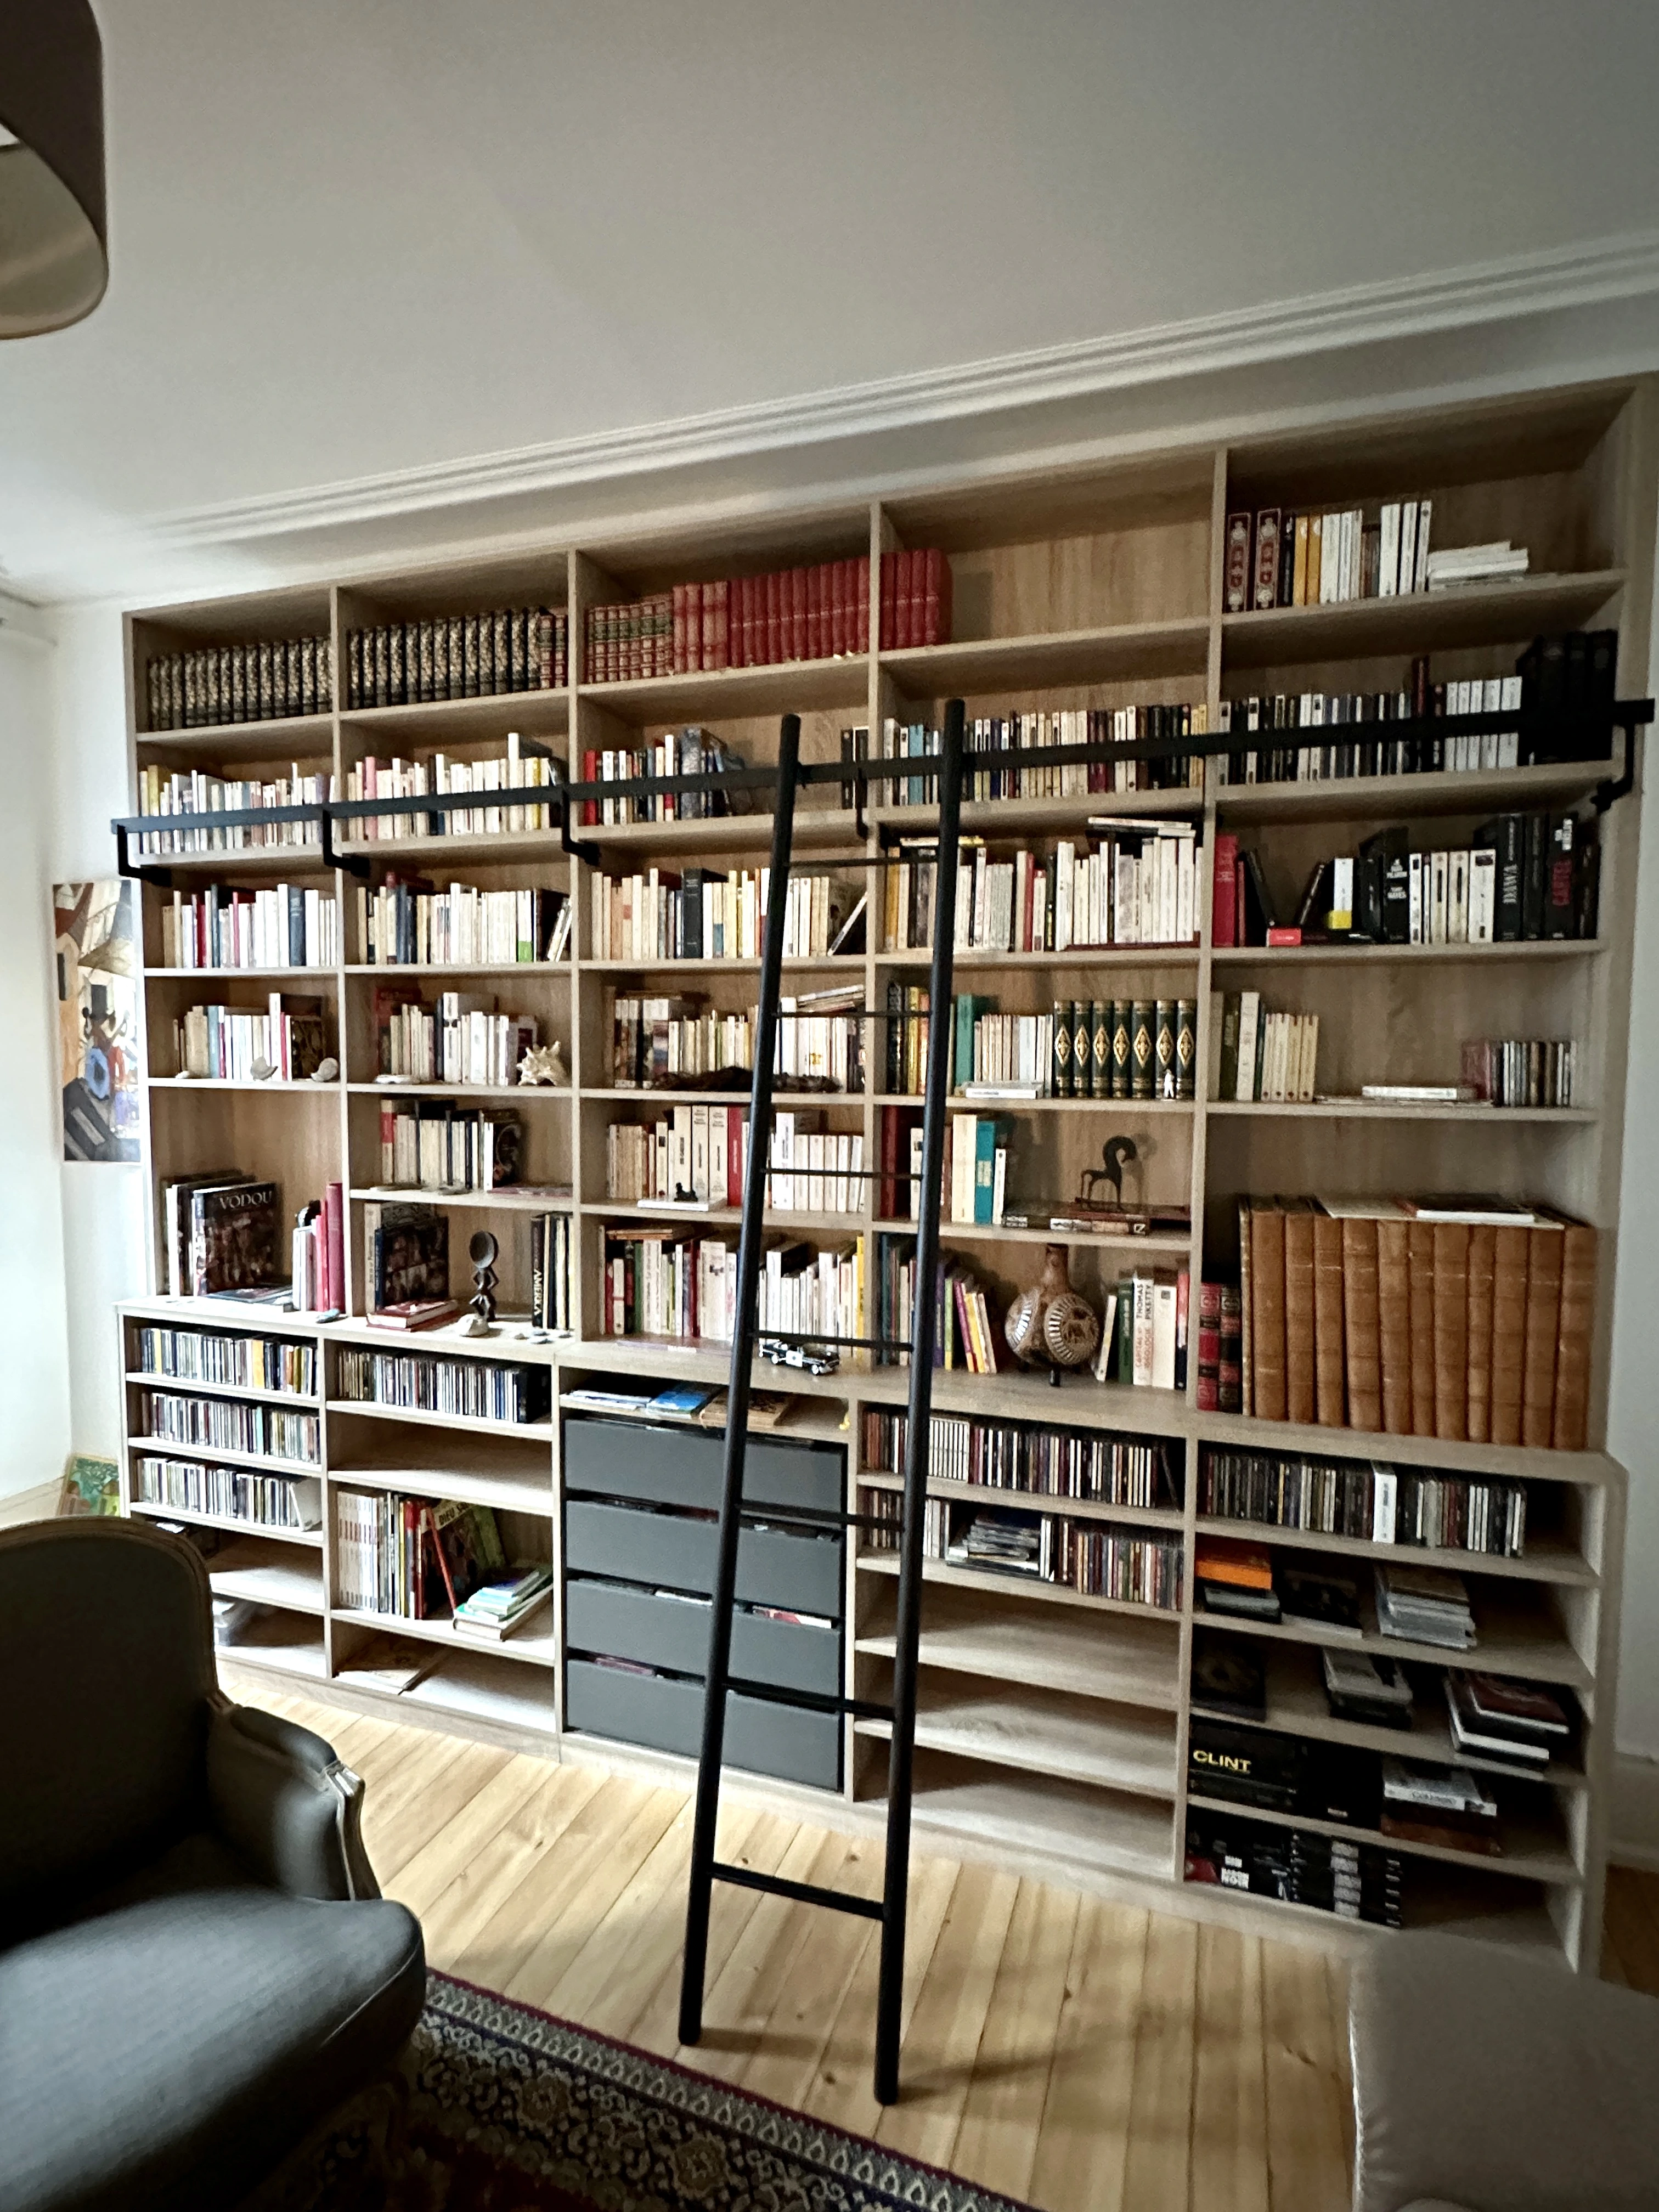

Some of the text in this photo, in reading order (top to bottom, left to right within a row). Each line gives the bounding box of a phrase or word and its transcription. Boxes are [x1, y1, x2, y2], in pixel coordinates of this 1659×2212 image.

[1502, 864, 1519, 905] DAWA
[219, 1191, 272, 1209] VODOU
[1136, 1283, 1144, 1319] THOMAS
[1193, 1750, 1251, 1774] CLINT
